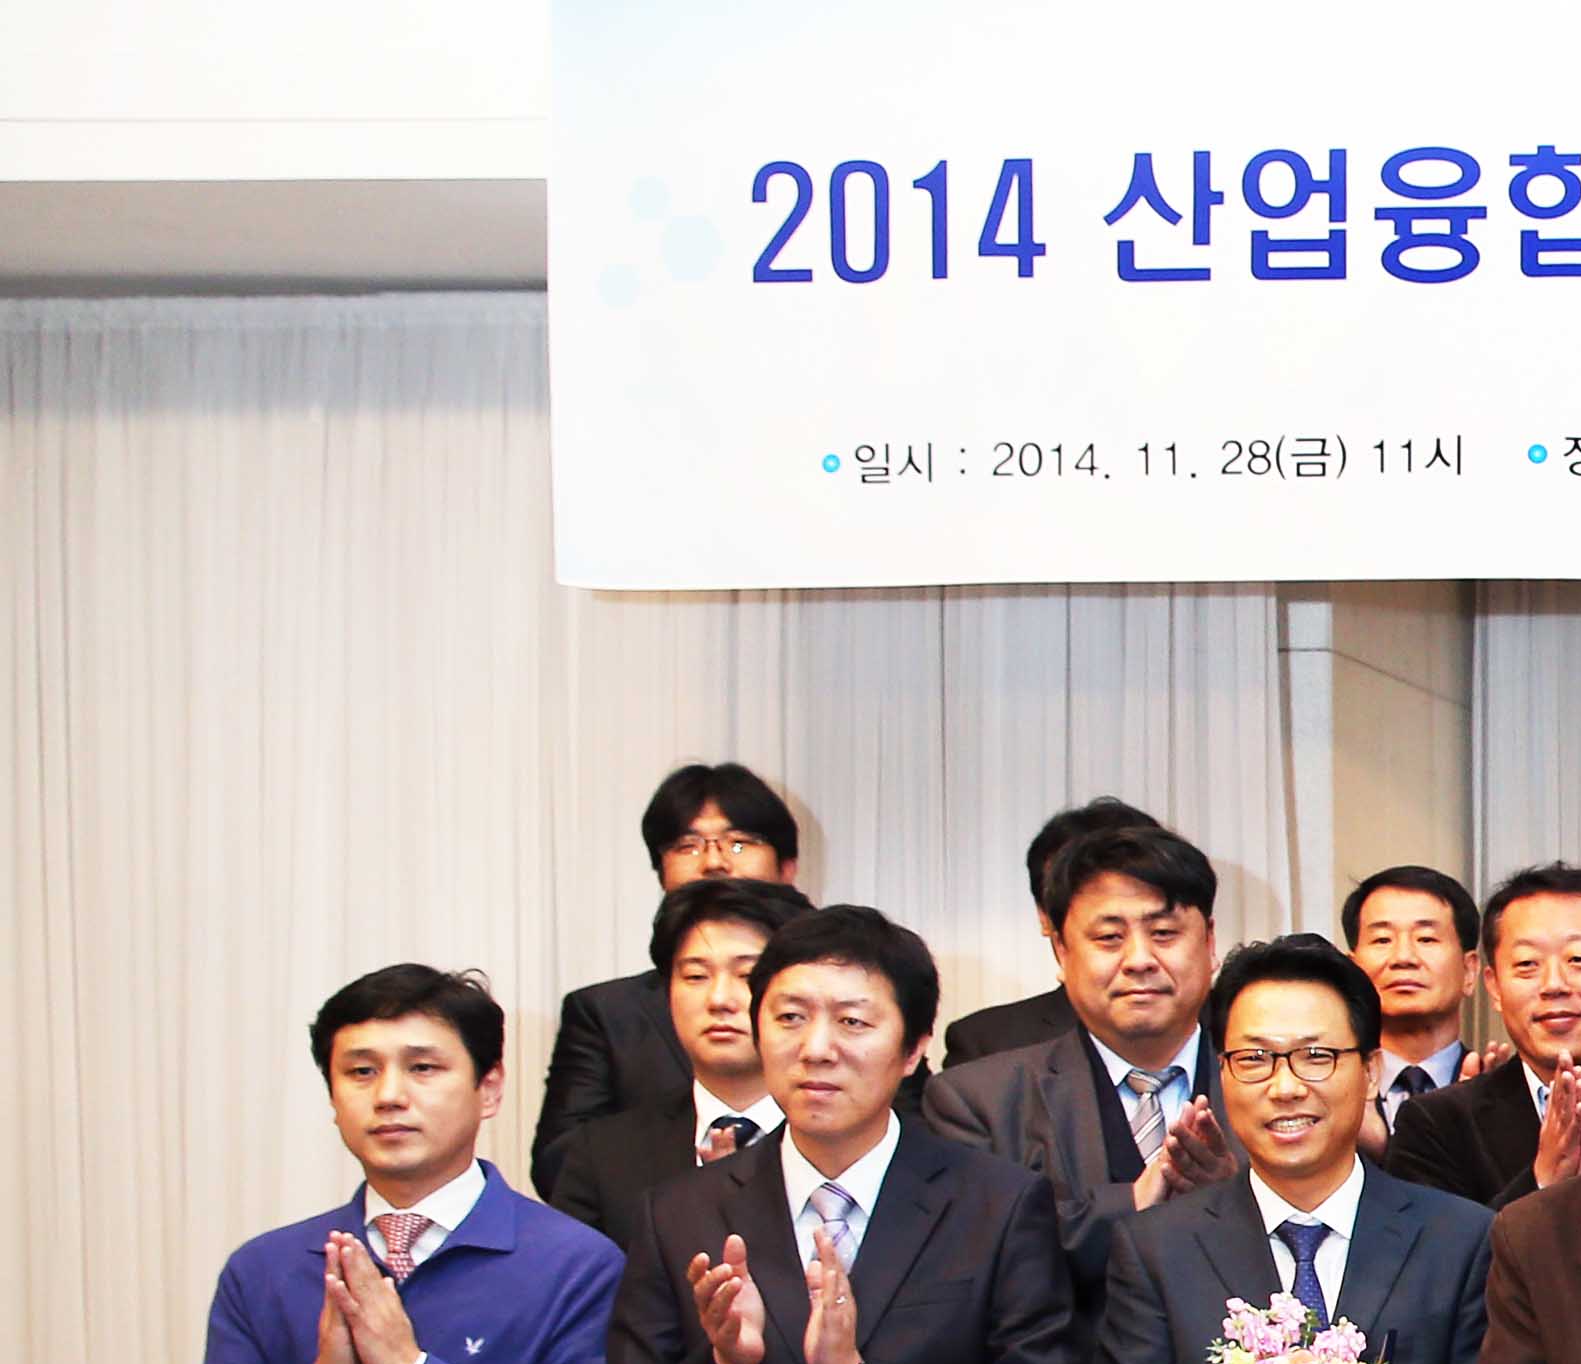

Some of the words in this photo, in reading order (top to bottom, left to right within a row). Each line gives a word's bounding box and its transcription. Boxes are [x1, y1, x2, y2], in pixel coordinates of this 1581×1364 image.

[750, 158, 1048, 284] 2014
[854, 441, 933, 485] 일시
[991, 441, 1111, 481] 2014.
[1137, 441, 1198, 480] 11.
[1220, 434, 1348, 480] 28(금)
[1372, 433, 1463, 477] 11시
